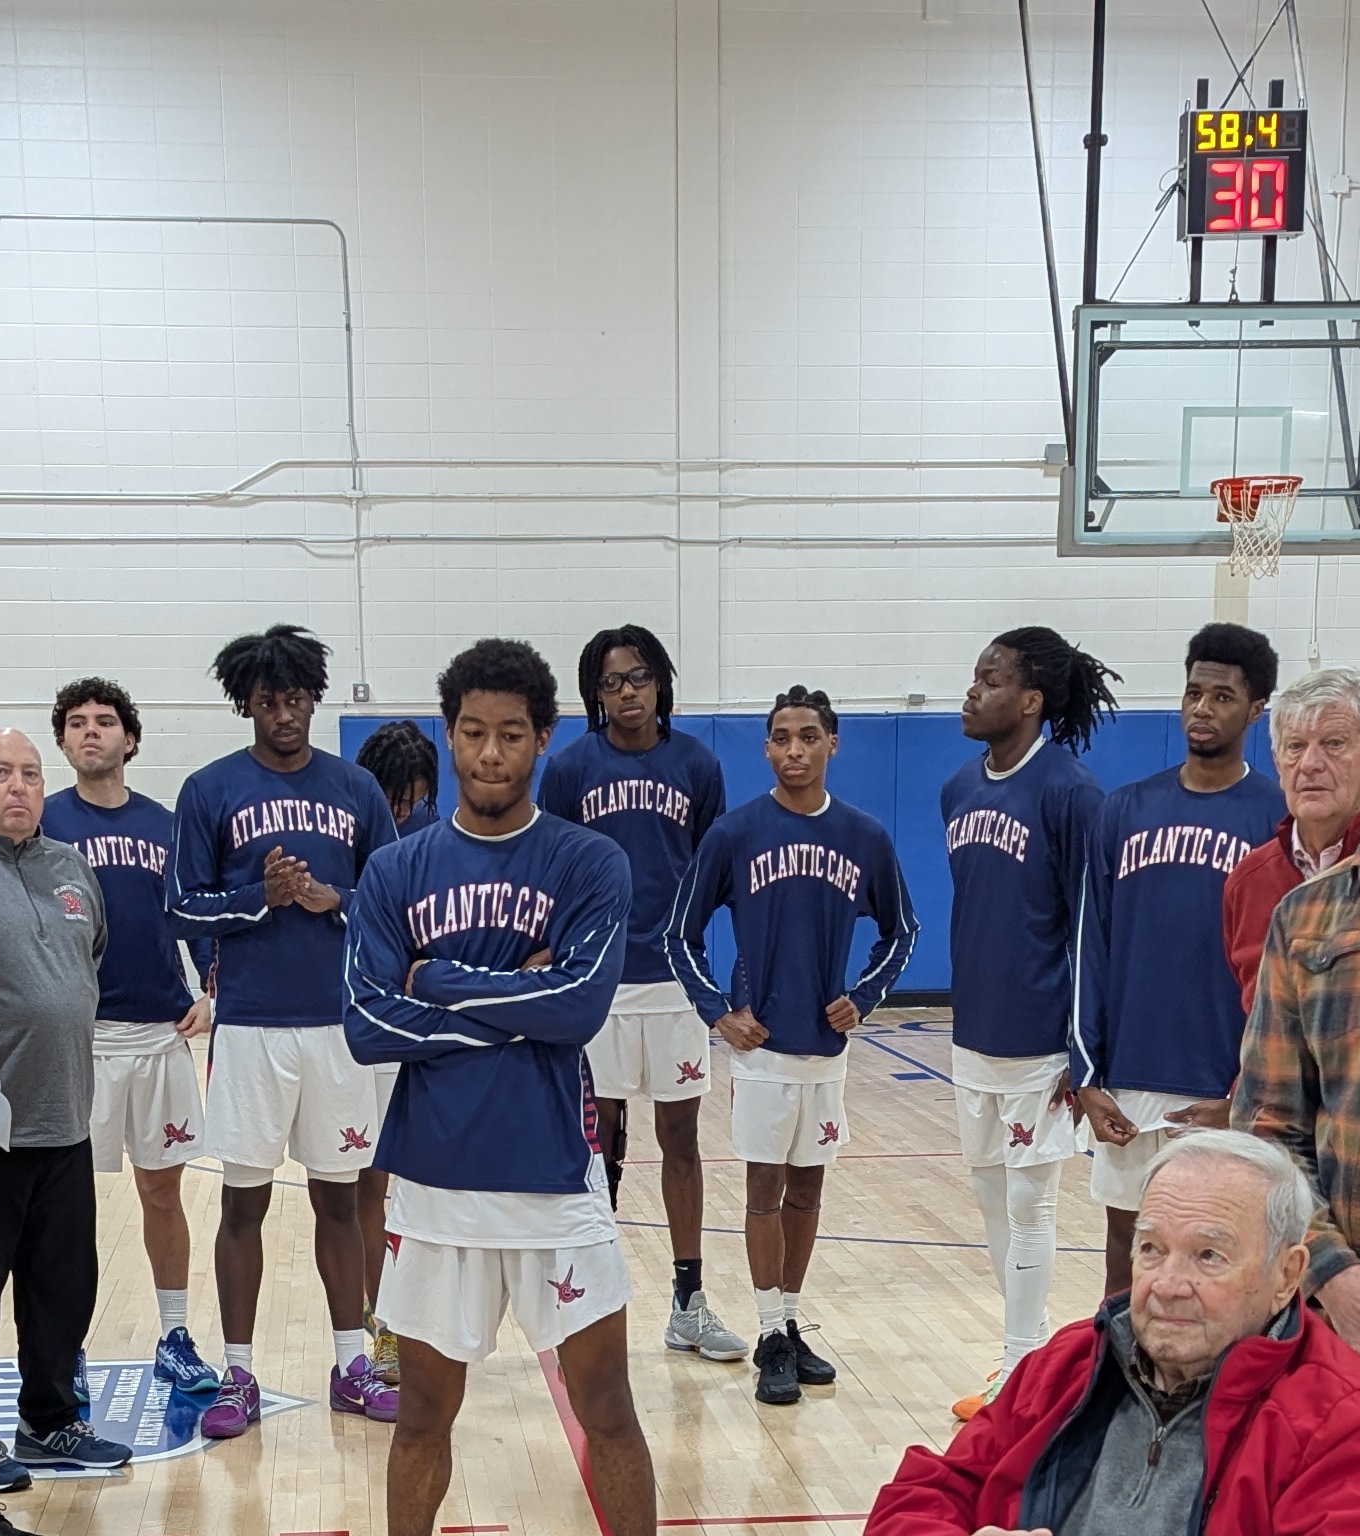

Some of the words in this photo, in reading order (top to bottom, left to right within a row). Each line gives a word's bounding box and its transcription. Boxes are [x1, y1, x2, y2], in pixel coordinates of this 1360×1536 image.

[1208, 162, 1285, 230] 30
[232, 800, 314, 849] ATLANTIC
[315, 802, 356, 848] CAPE
[582, 780, 653, 824] ATLANTIC
[655, 782, 691, 828] CAPE
[993, 812, 1030, 864] CAPE
[1118, 826, 1213, 880] ATLANTIC
[1211, 831, 1252, 875] CAP
[750, 843, 825, 895] ATLANTIC
[826, 849, 861, 903] CAPE
[113, 1368, 144, 1396] COLLEGE
[132, 1410, 167, 1446] ATHLETIC
